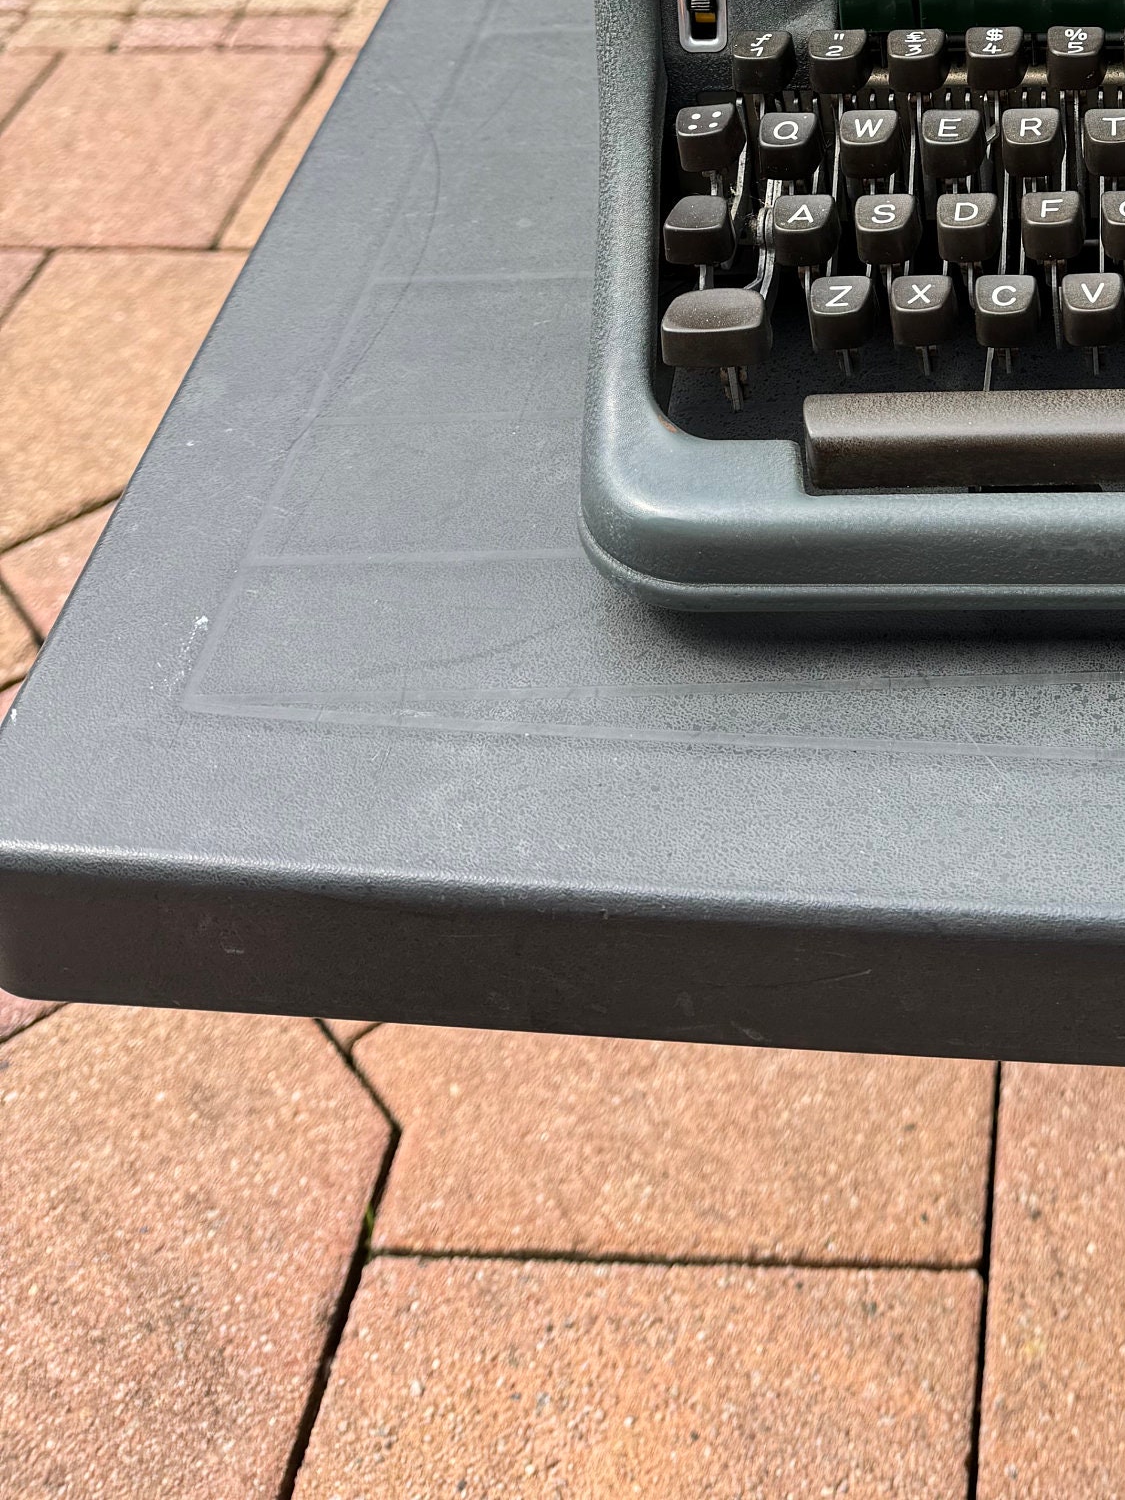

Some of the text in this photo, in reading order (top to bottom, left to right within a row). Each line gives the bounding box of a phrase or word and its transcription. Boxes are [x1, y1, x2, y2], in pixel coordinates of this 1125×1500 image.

[985, 28, 1004, 42] $
[1064, 28, 1088, 41] %
[750, 46, 764, 57] 1
[825, 45, 844, 57] 2
[904, 44, 923, 57] 3
[982, 42, 1002, 54] 4
[1067, 41, 1084, 55] 5
[773, 120, 799, 141] Q
[854, 118, 884, 138] W
[937, 117, 962, 137] E
[1019, 117, 1043, 137] R
[1102, 116, 1125, 136] T
[786, 204, 814, 224] A
[871, 203, 896, 224] S
[954, 201, 979, 222] D
[1040, 198, 1064, 218] F
[825, 285, 853, 307] Z
[907, 283, 932, 305] X
[991, 285, 1017, 307] C
[1080, 282, 1105, 304] V
